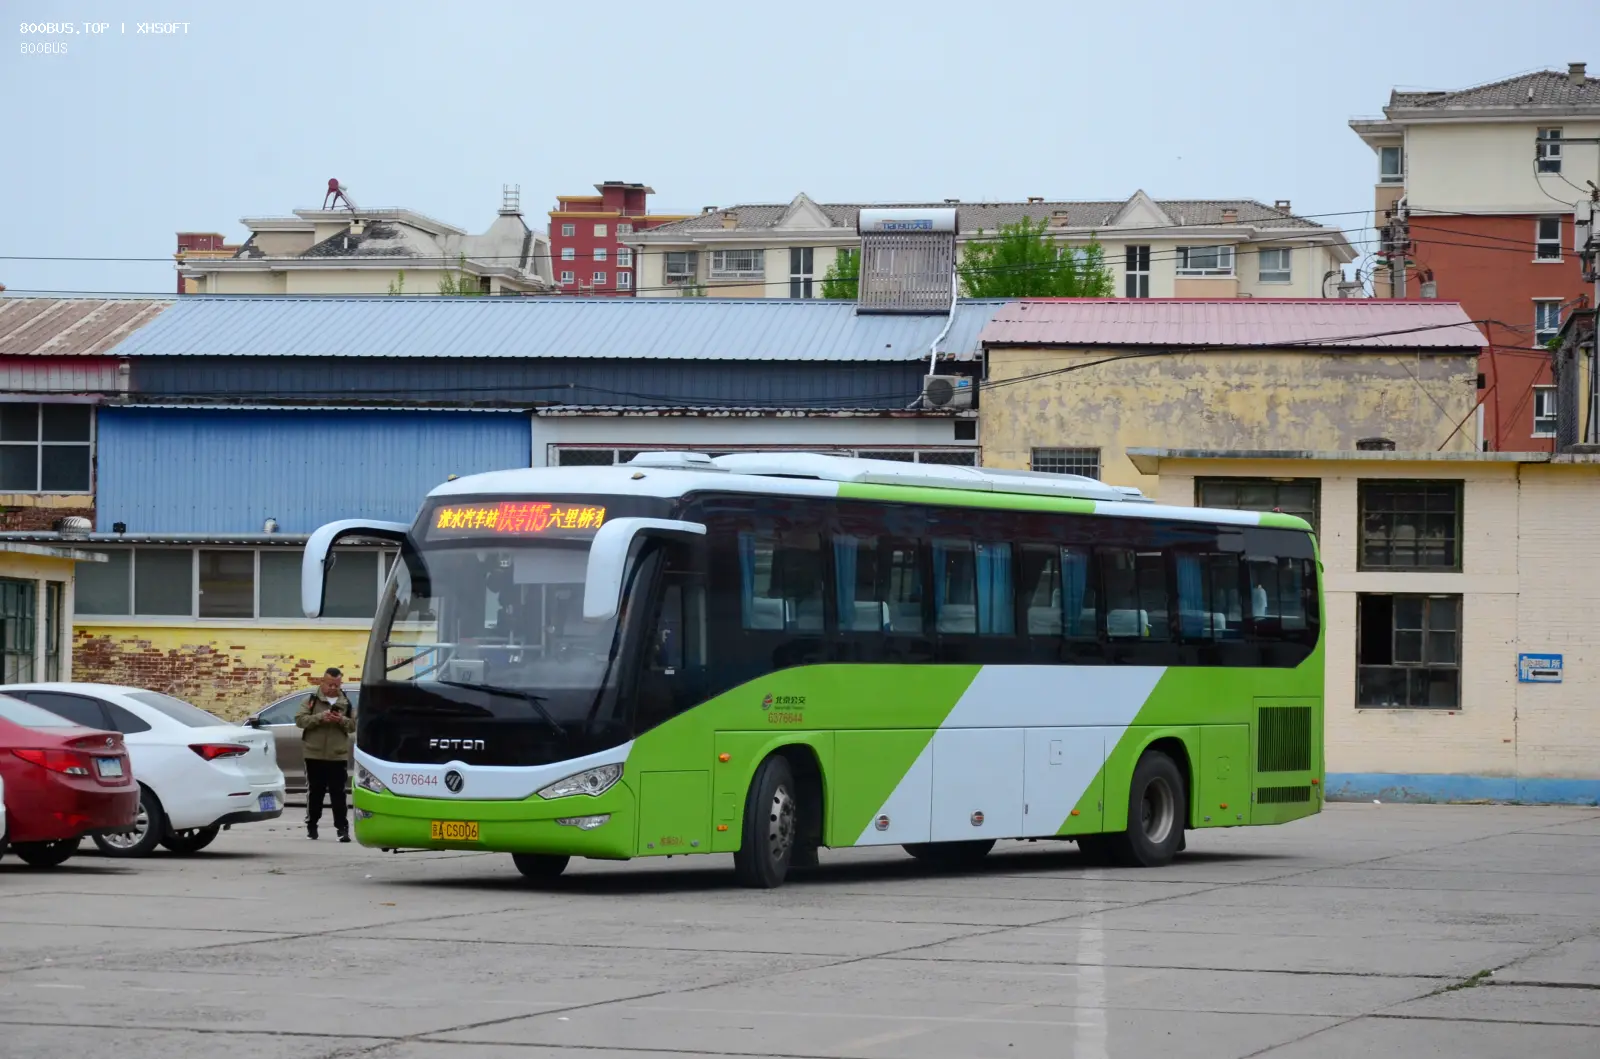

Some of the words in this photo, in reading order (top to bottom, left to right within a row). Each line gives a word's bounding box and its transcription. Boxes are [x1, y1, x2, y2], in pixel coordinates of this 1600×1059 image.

[775, 696, 806, 705] 北京公交
[768, 712, 804, 724] 6376644
[429, 738, 485, 751] FOTON
[391, 773, 438, 786] 6376644
